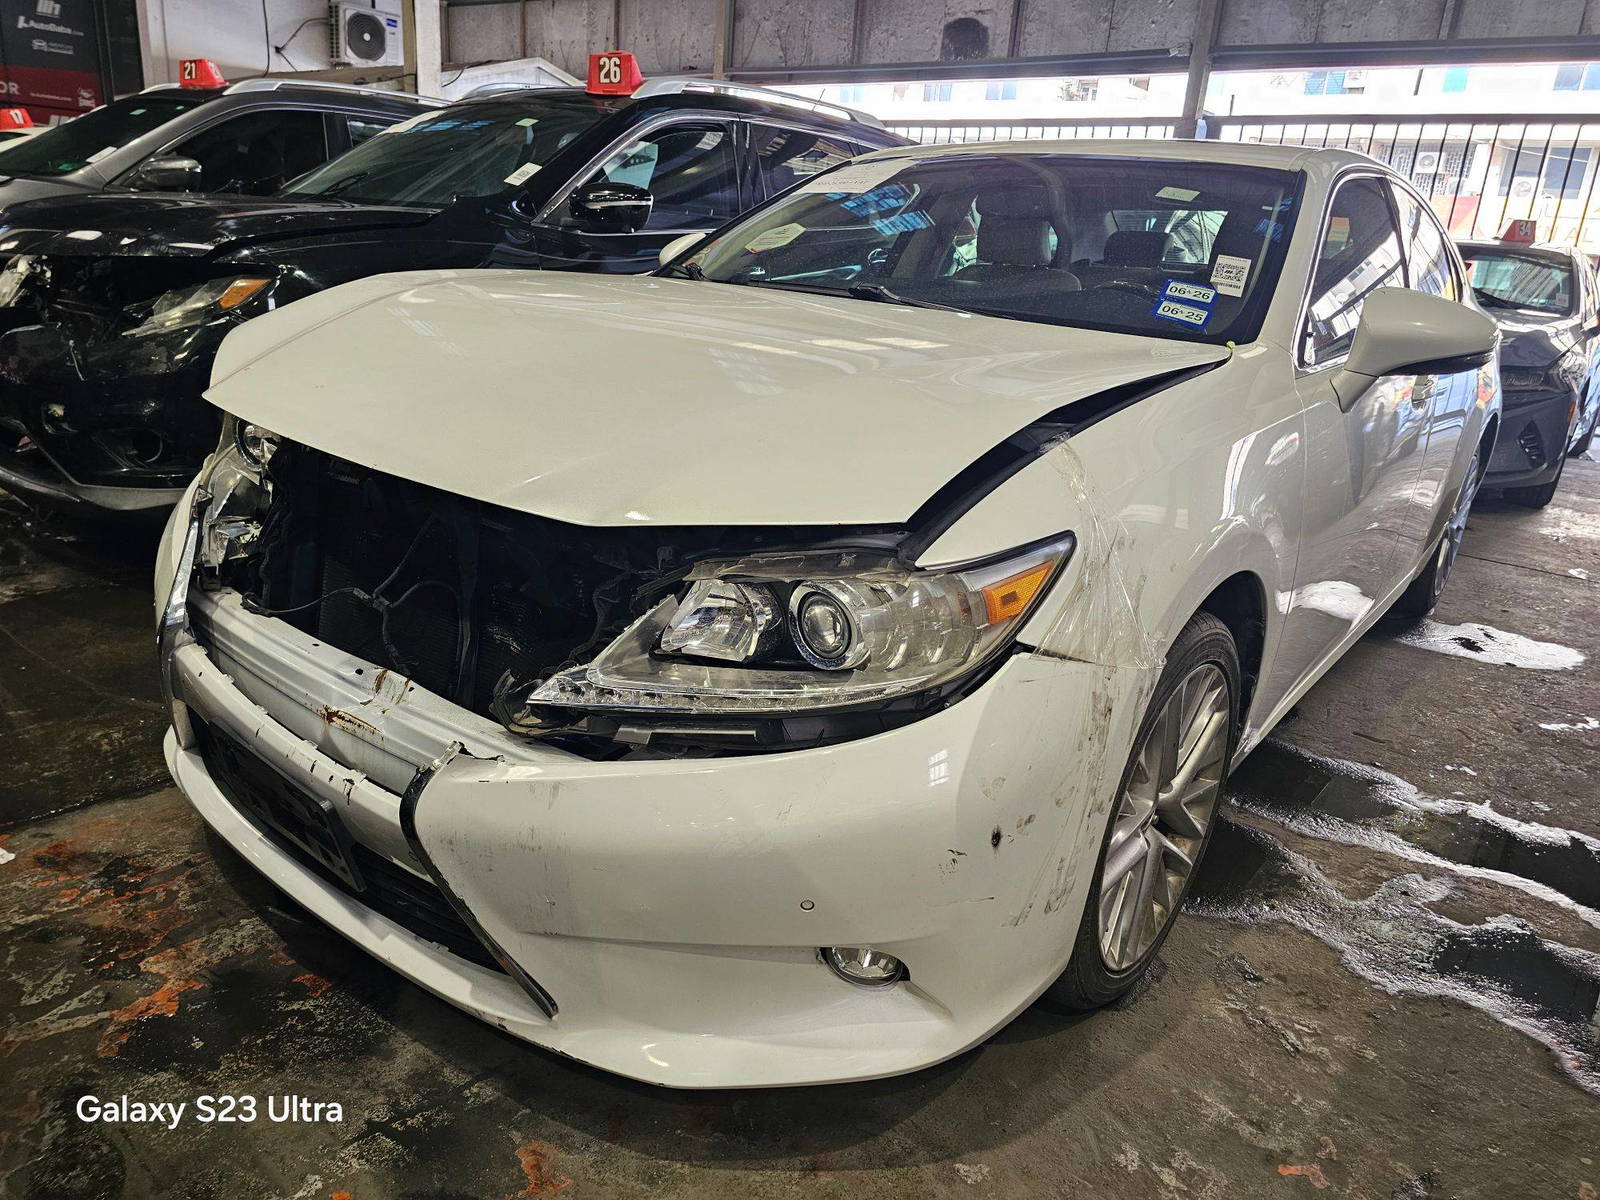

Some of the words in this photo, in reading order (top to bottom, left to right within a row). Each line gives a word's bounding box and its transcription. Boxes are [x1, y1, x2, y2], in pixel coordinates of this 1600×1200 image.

[184, 62, 196, 80] 21
[599, 57, 621, 83] 26
[1169, 286, 1187, 295] 06
[1193, 290, 1210, 300] 26
[1162, 305, 1180, 315] 06
[1185, 311, 1203, 321] 25
